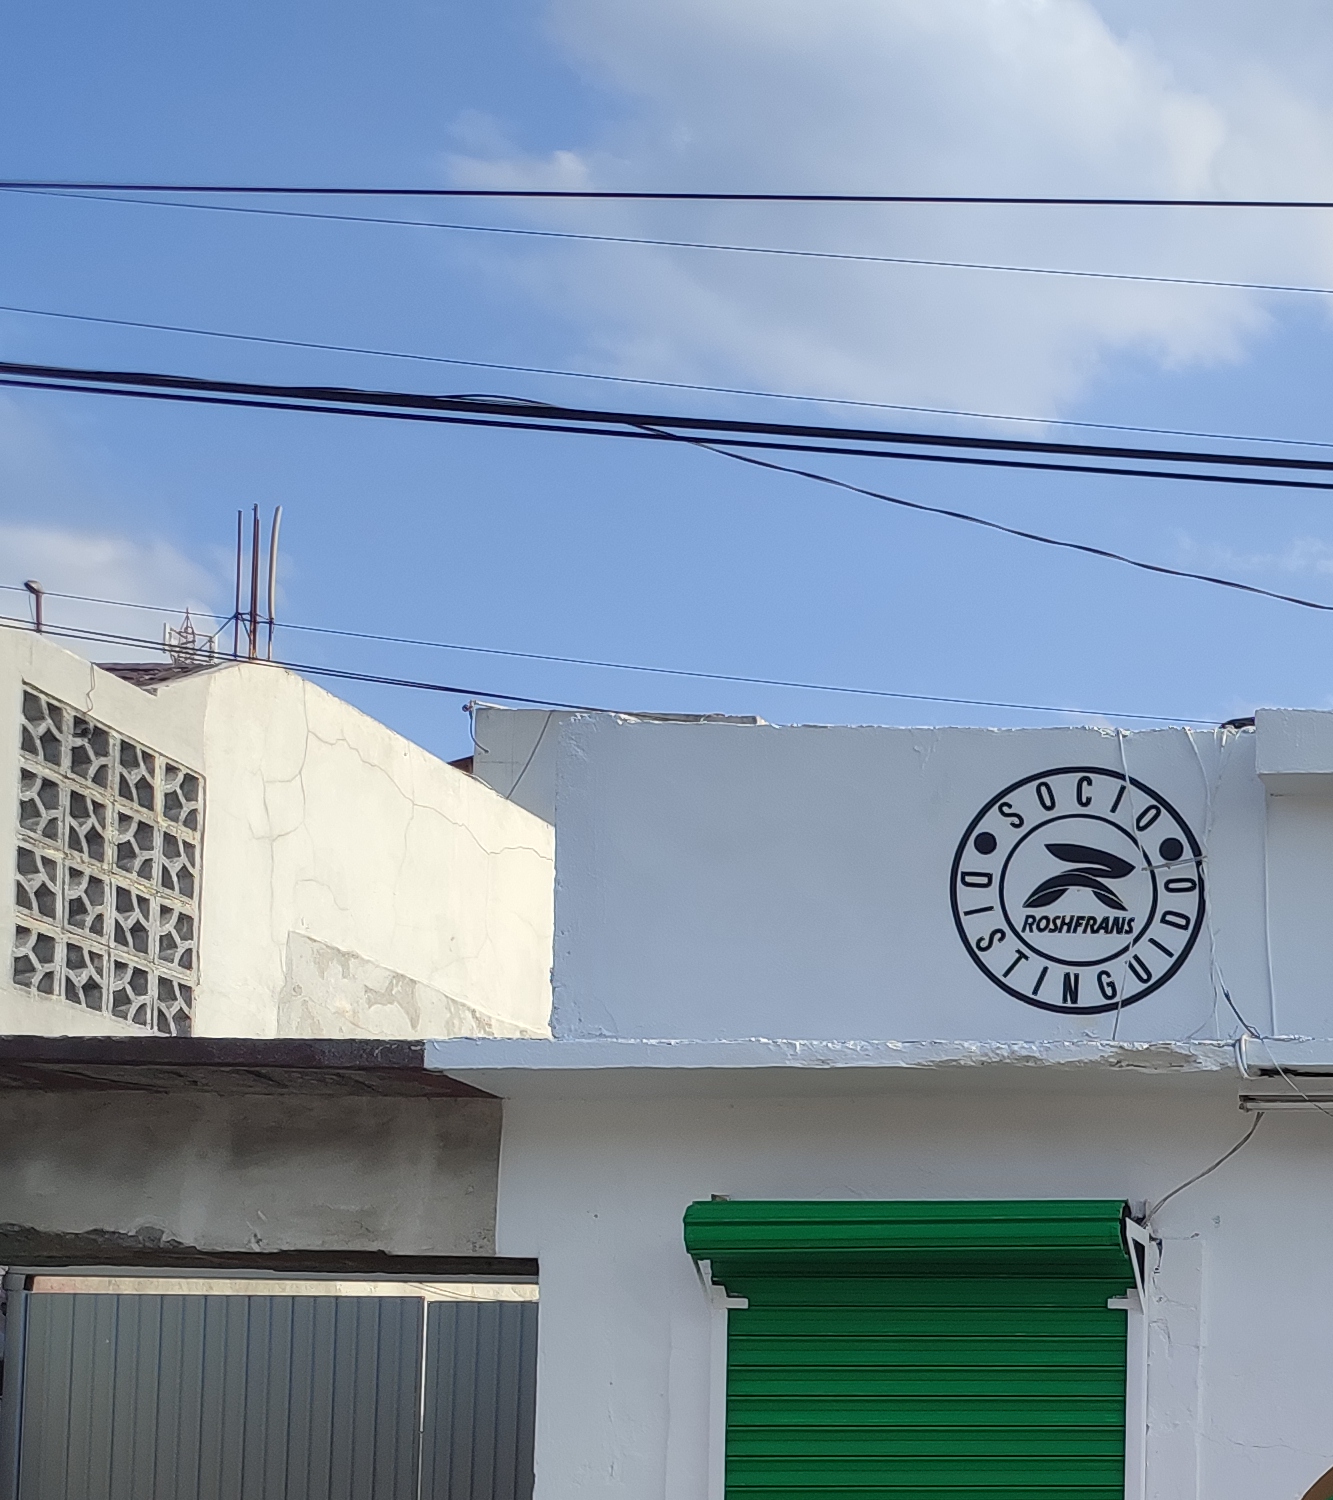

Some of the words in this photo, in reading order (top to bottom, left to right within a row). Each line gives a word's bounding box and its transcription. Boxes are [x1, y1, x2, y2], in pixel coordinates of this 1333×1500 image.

[997, 775, 1162, 832] SOCIO
[960, 870, 1197, 1005] DISTINGUIDO
[1021, 914, 1135, 936] ROSHFRANS
